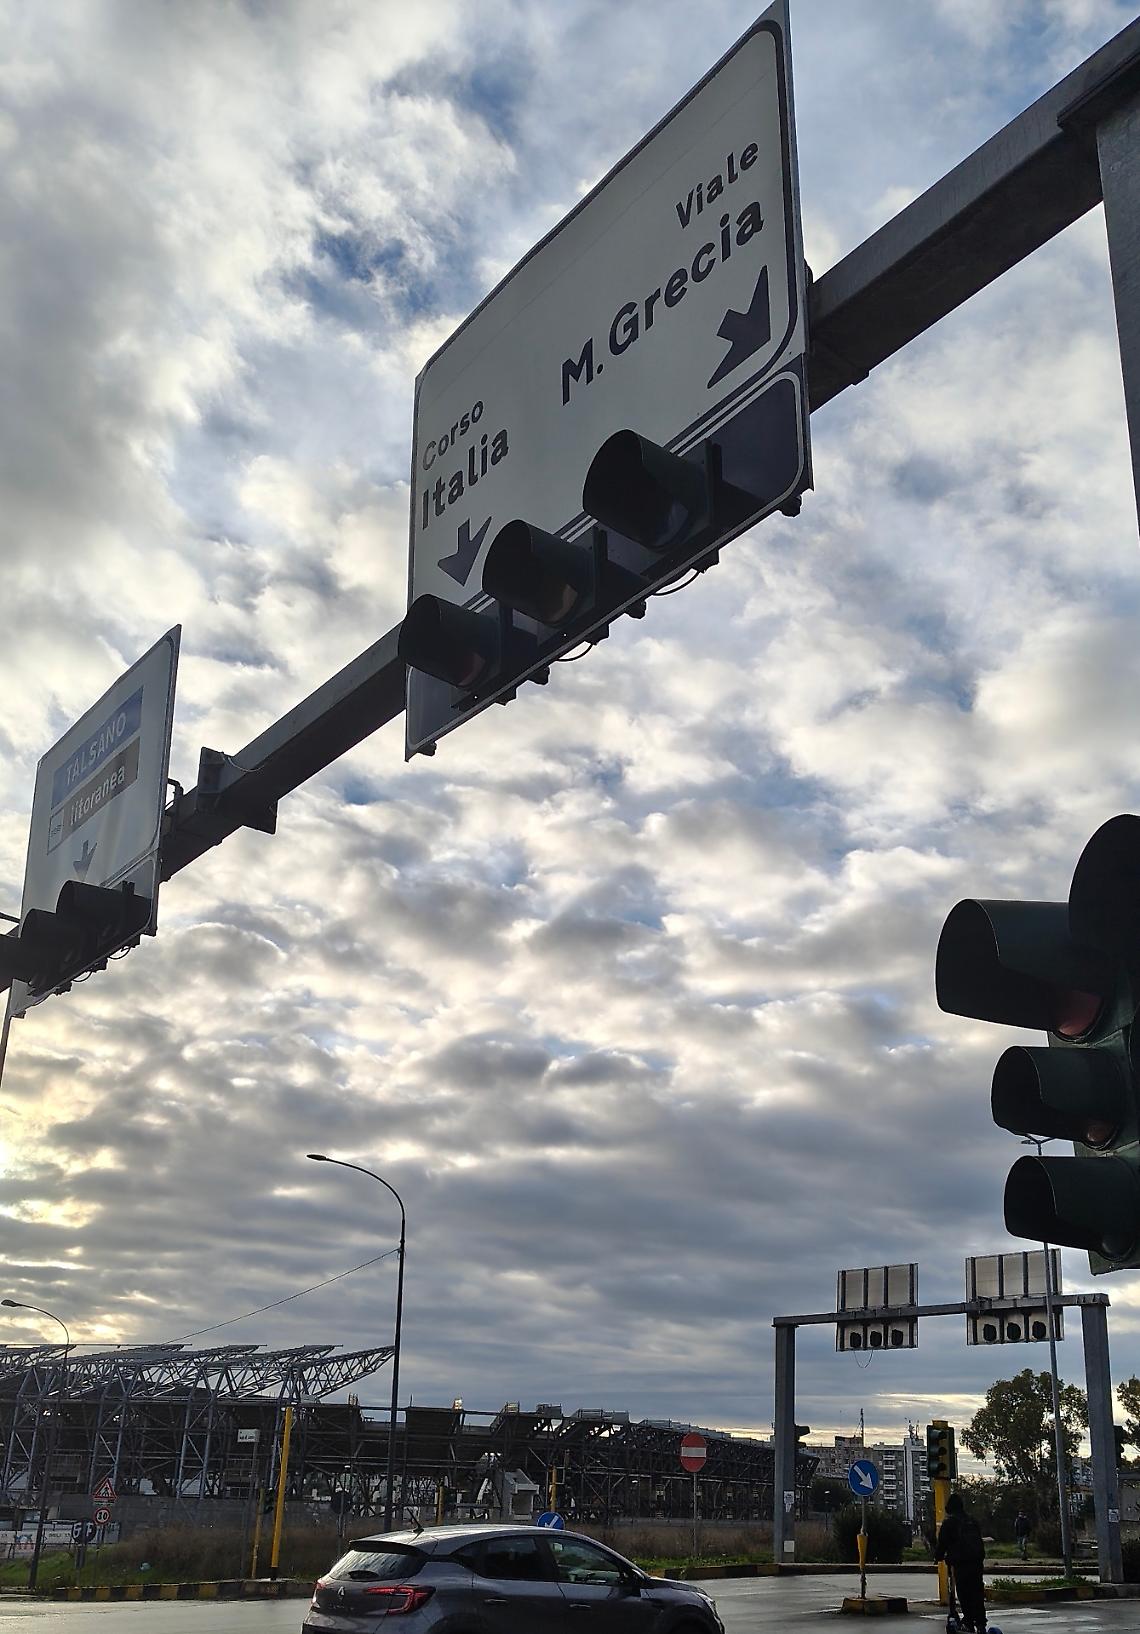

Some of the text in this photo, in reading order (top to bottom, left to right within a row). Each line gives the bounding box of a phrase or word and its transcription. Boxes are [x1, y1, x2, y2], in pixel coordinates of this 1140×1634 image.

[675, 142, 759, 229] Viale
[561, 201, 765, 406] M. Grecia
[422, 401, 484, 471] Corso
[421, 428, 510, 531] Italia
[65, 711, 128, 787] TALSANO
[70, 764, 126, 826] litoranea
